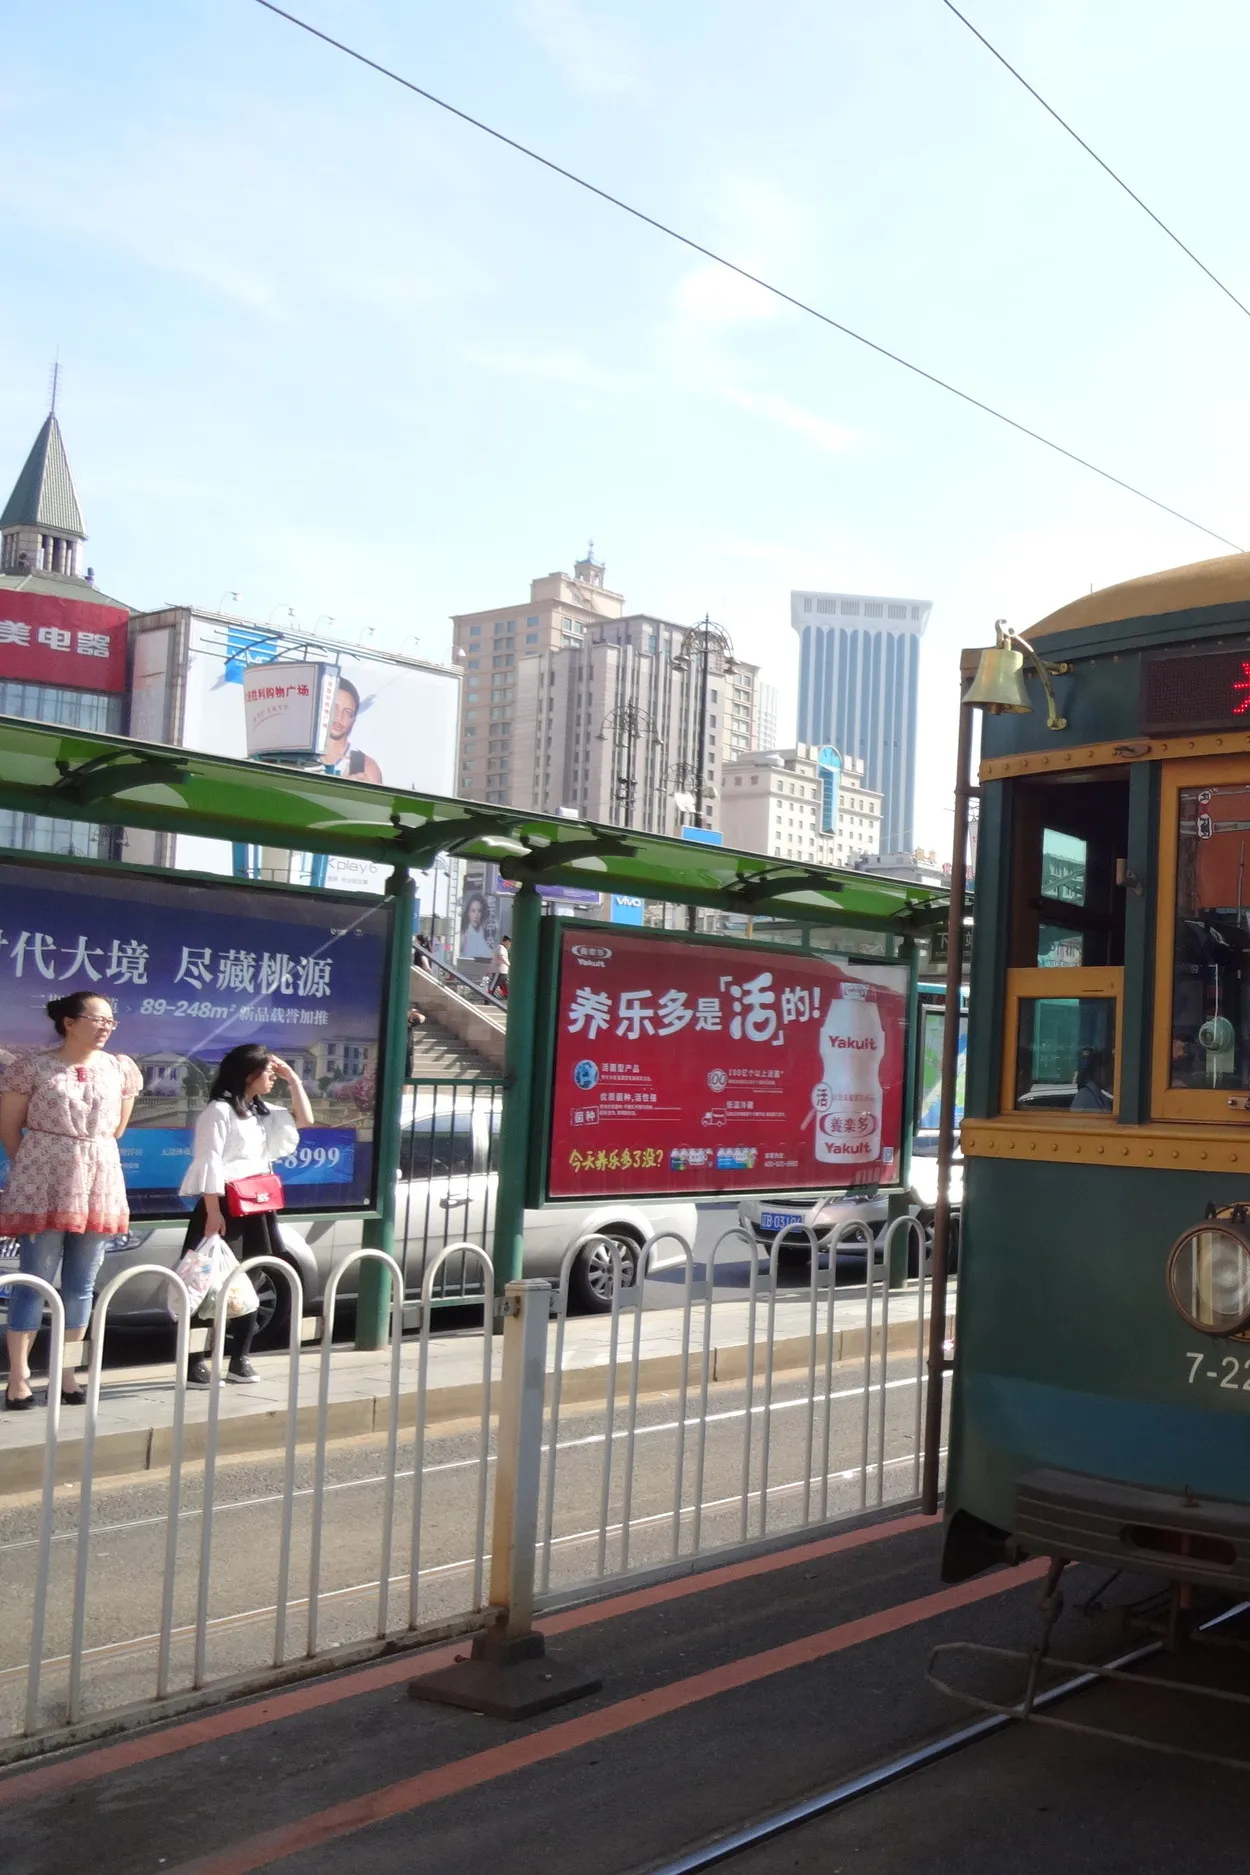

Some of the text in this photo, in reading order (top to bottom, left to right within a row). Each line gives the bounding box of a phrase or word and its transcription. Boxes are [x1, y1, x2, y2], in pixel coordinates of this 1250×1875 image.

[0, 619, 110, 658] 美电器
[616, 896, 642, 907] vivo
[0, 930, 334, 998] 代大境 尽藏桃源
[239, 1006, 329, 1026] 新品载誉加推
[829, 1035, 878, 1051] Yakult
[816, 1088, 829, 1108] 活
[825, 1142, 873, 1155] Yakult
